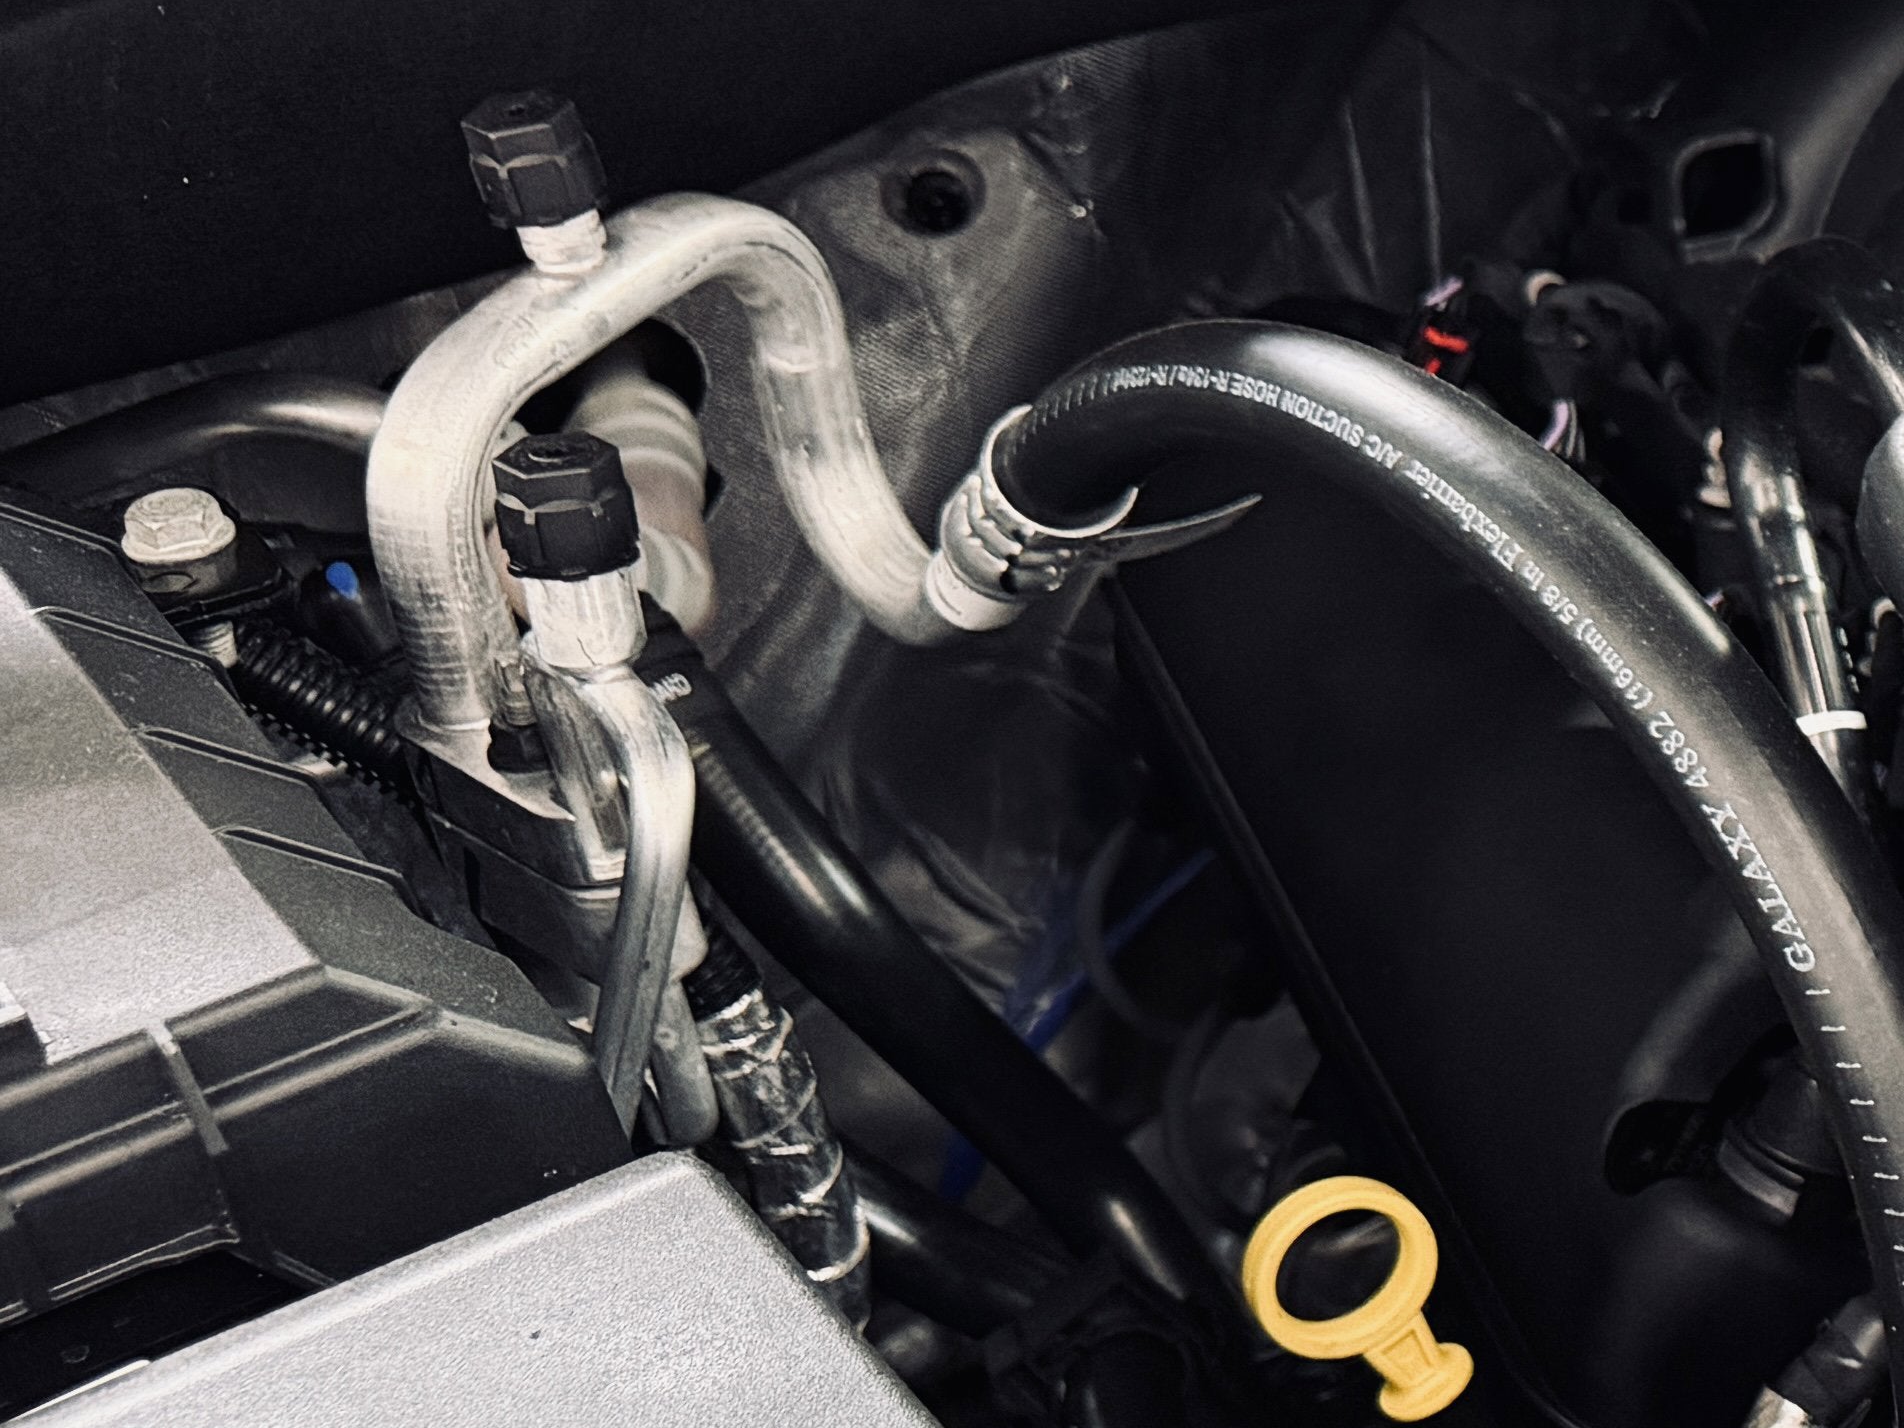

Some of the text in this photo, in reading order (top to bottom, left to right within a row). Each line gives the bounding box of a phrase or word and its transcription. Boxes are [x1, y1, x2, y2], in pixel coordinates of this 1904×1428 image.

[1229, 372, 1281, 408] HOSE
[1280, 390, 1365, 448] SUCTION
[1363, 434, 1403, 469] A/C
[1403, 460, 1525, 572] Flexbarrier
[1541, 585, 1579, 625] 5/8
[1575, 618, 1654, 710] (16mm)
[1649, 711, 1710, 788] 4882
[1701, 801, 1817, 973] GALAXY
